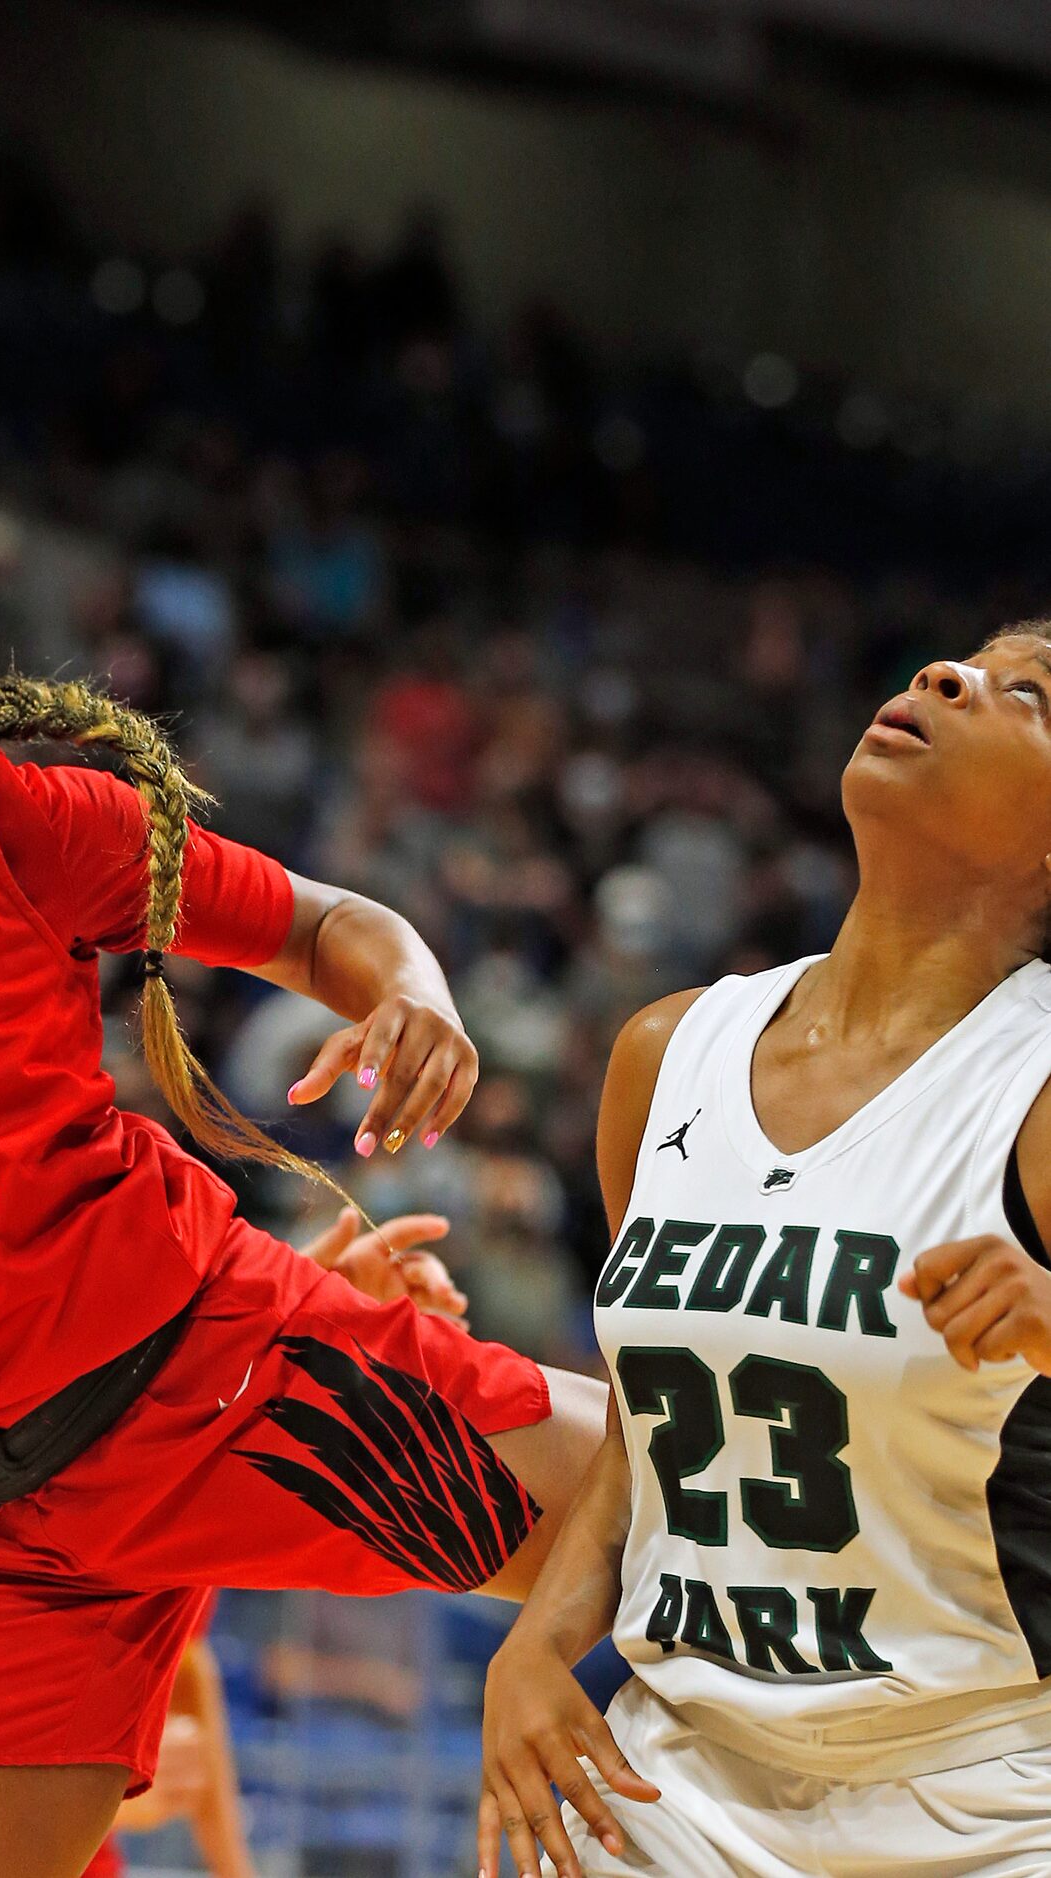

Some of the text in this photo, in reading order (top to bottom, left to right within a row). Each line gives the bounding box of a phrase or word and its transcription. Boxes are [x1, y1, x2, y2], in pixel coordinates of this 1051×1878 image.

[596, 1217, 901, 1338] CEDAR
[616, 1346, 860, 1554] 23
[646, 1573, 893, 1675] PARK
